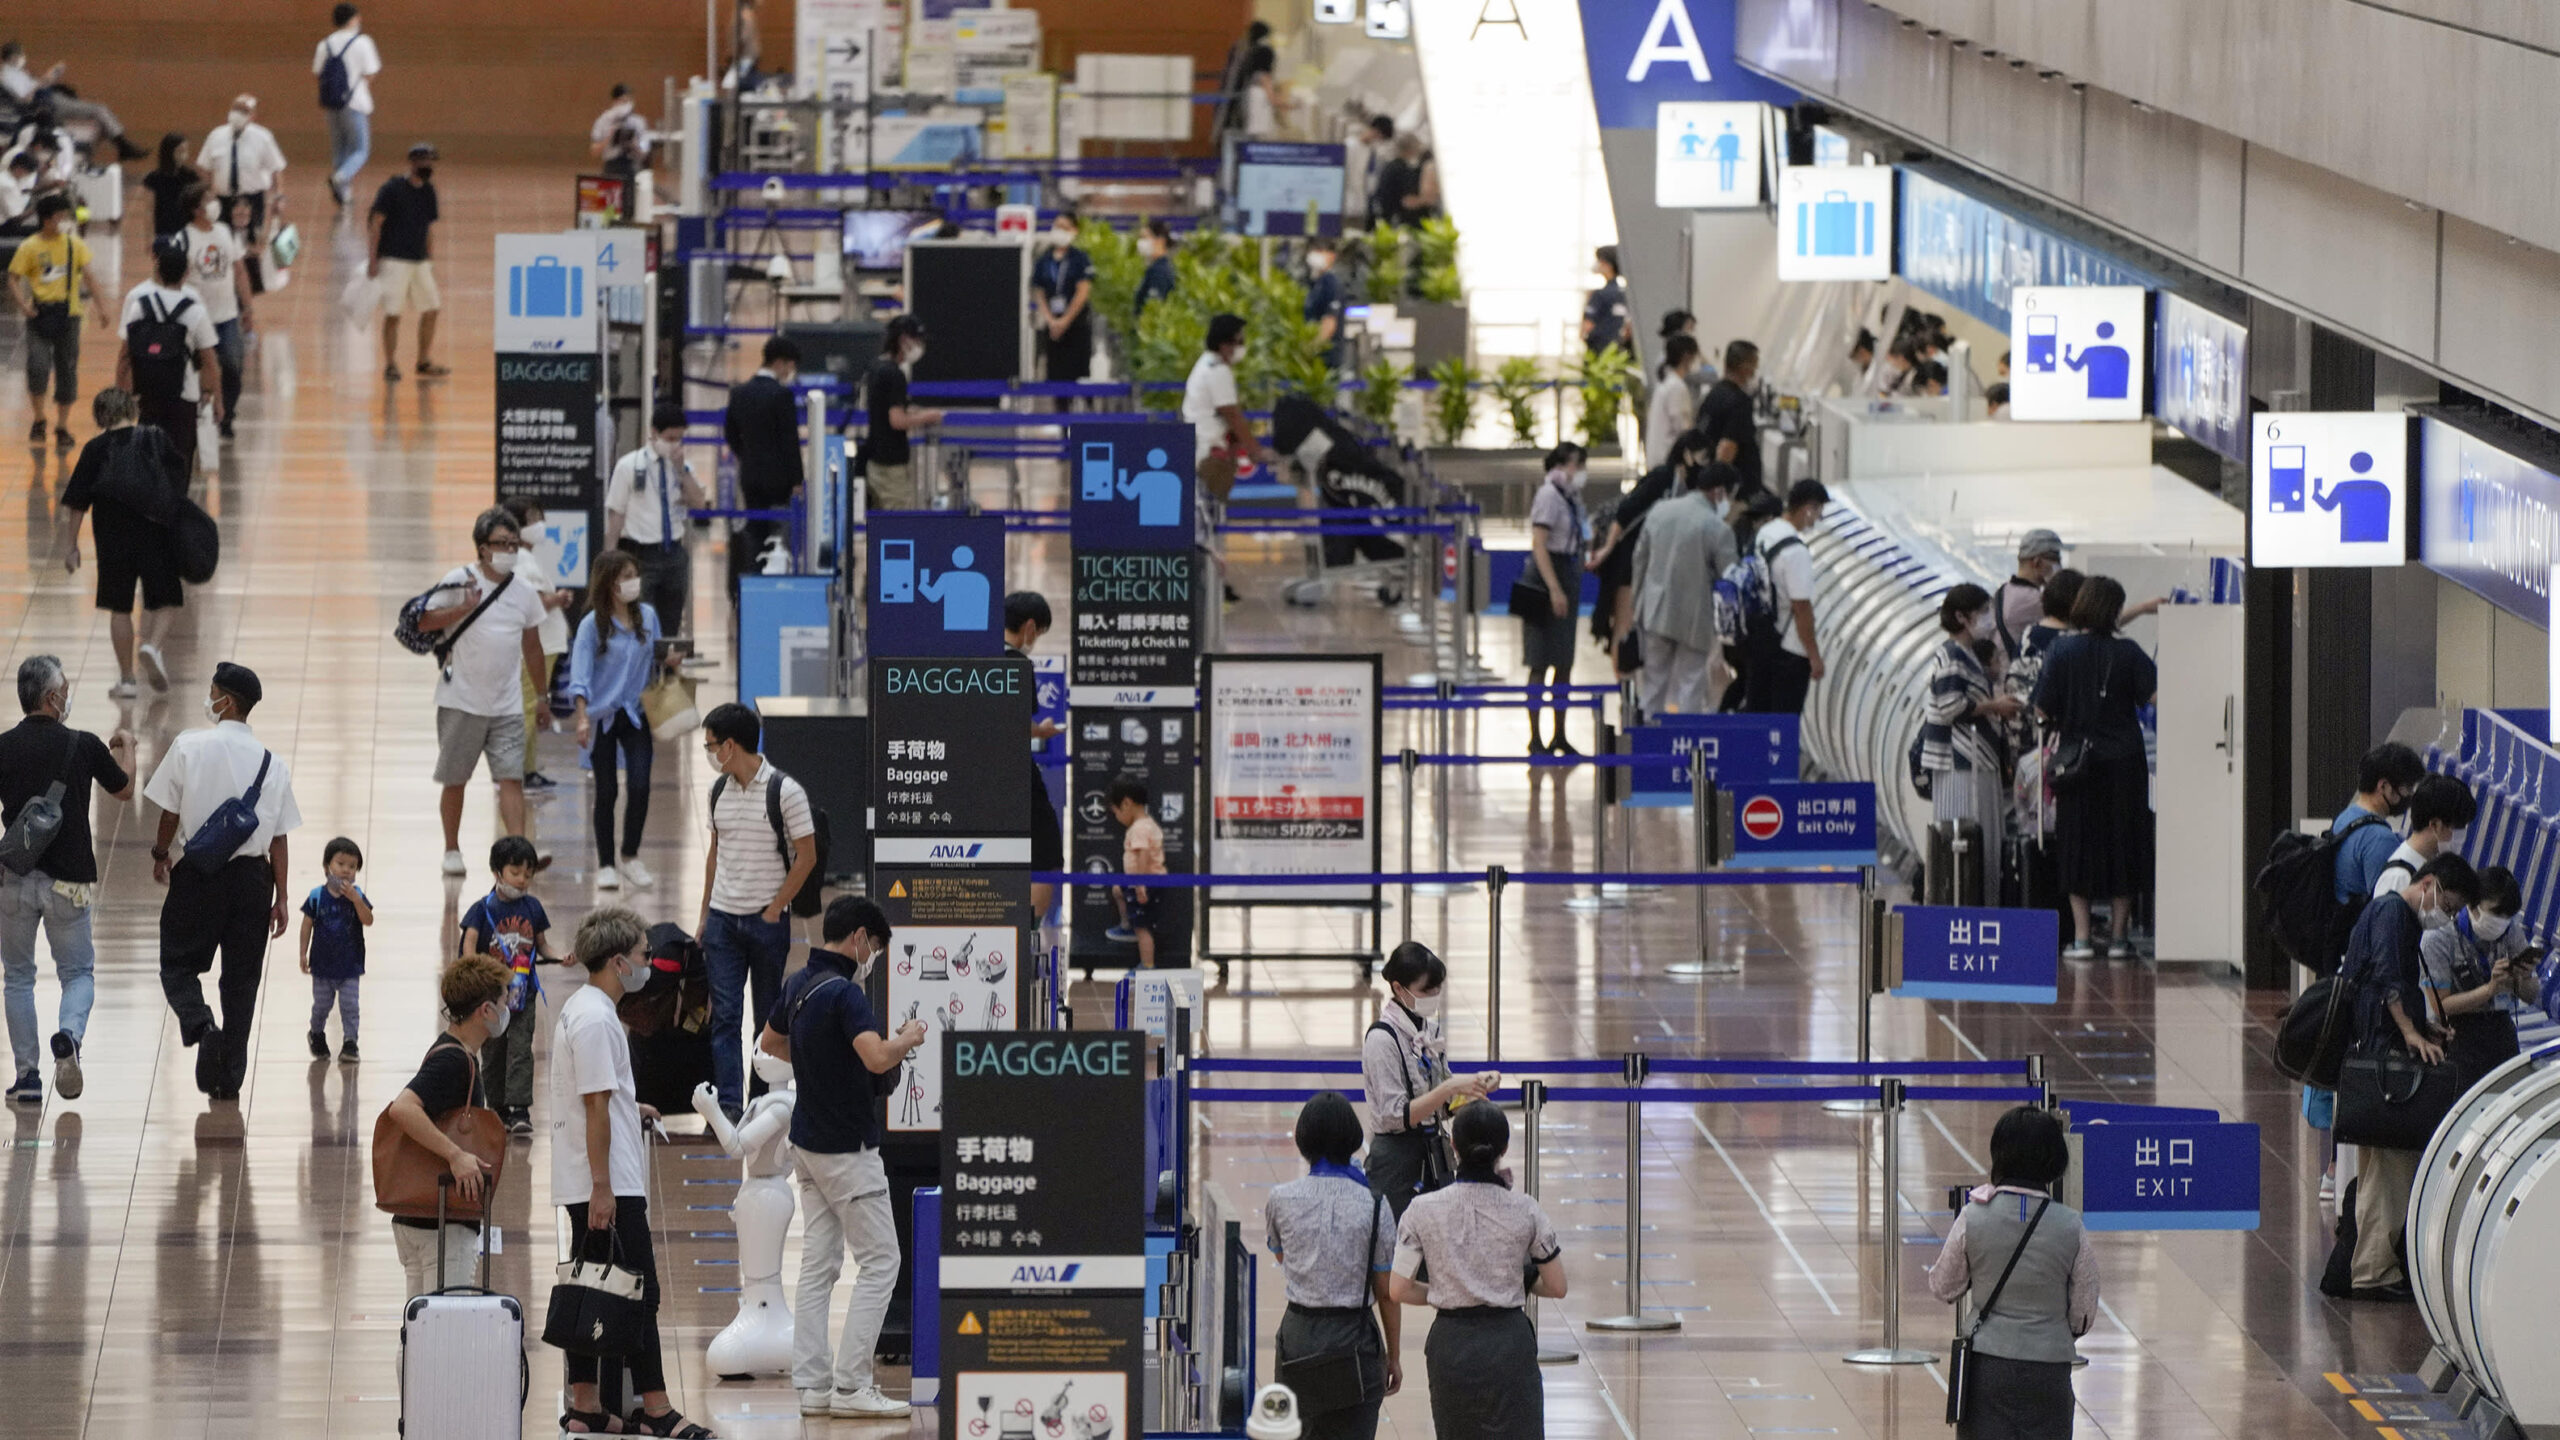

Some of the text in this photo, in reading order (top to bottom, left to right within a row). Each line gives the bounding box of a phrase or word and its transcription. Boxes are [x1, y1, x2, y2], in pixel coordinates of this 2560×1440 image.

[1469, 0, 1528, 40] A
[1626, 0, 1712, 82] A
[597, 242, 619, 272] 4
[2025, 292, 2037, 311] 6
[502, 362, 591, 381] BAGGAGE
[2267, 419, 2281, 441] 6
[1078, 556, 1189, 578] TICKETING
[1167, 580, 1189, 601] IN
[1078, 636, 1189, 650] Ticketing & Check In
[887, 668, 1020, 694] BAGGAGE
[1113, 691, 1141, 703] ANA
[887, 740, 946, 760] 手荷物
[1672, 736, 1719, 758] 出口
[887, 768, 948, 784] Baggage
[1672, 767, 1718, 783] EXT
[1798, 798, 1856, 816] 出口専用
[1798, 820, 1856, 835] Exit Only
[930, 845, 964, 858] ANA
[1949, 918, 2001, 946] 出口
[1949, 954, 2000, 972] EXIT
[956, 1041, 1131, 1076] BAGGAGE
[956, 1137, 1034, 1163] 手荷物
[2135, 1137, 2194, 1166] 出口
[956, 1172, 1037, 1195] Baggage
[2136, 1178, 2193, 1196] EXIT
[1011, 1266, 1056, 1283] ANA
